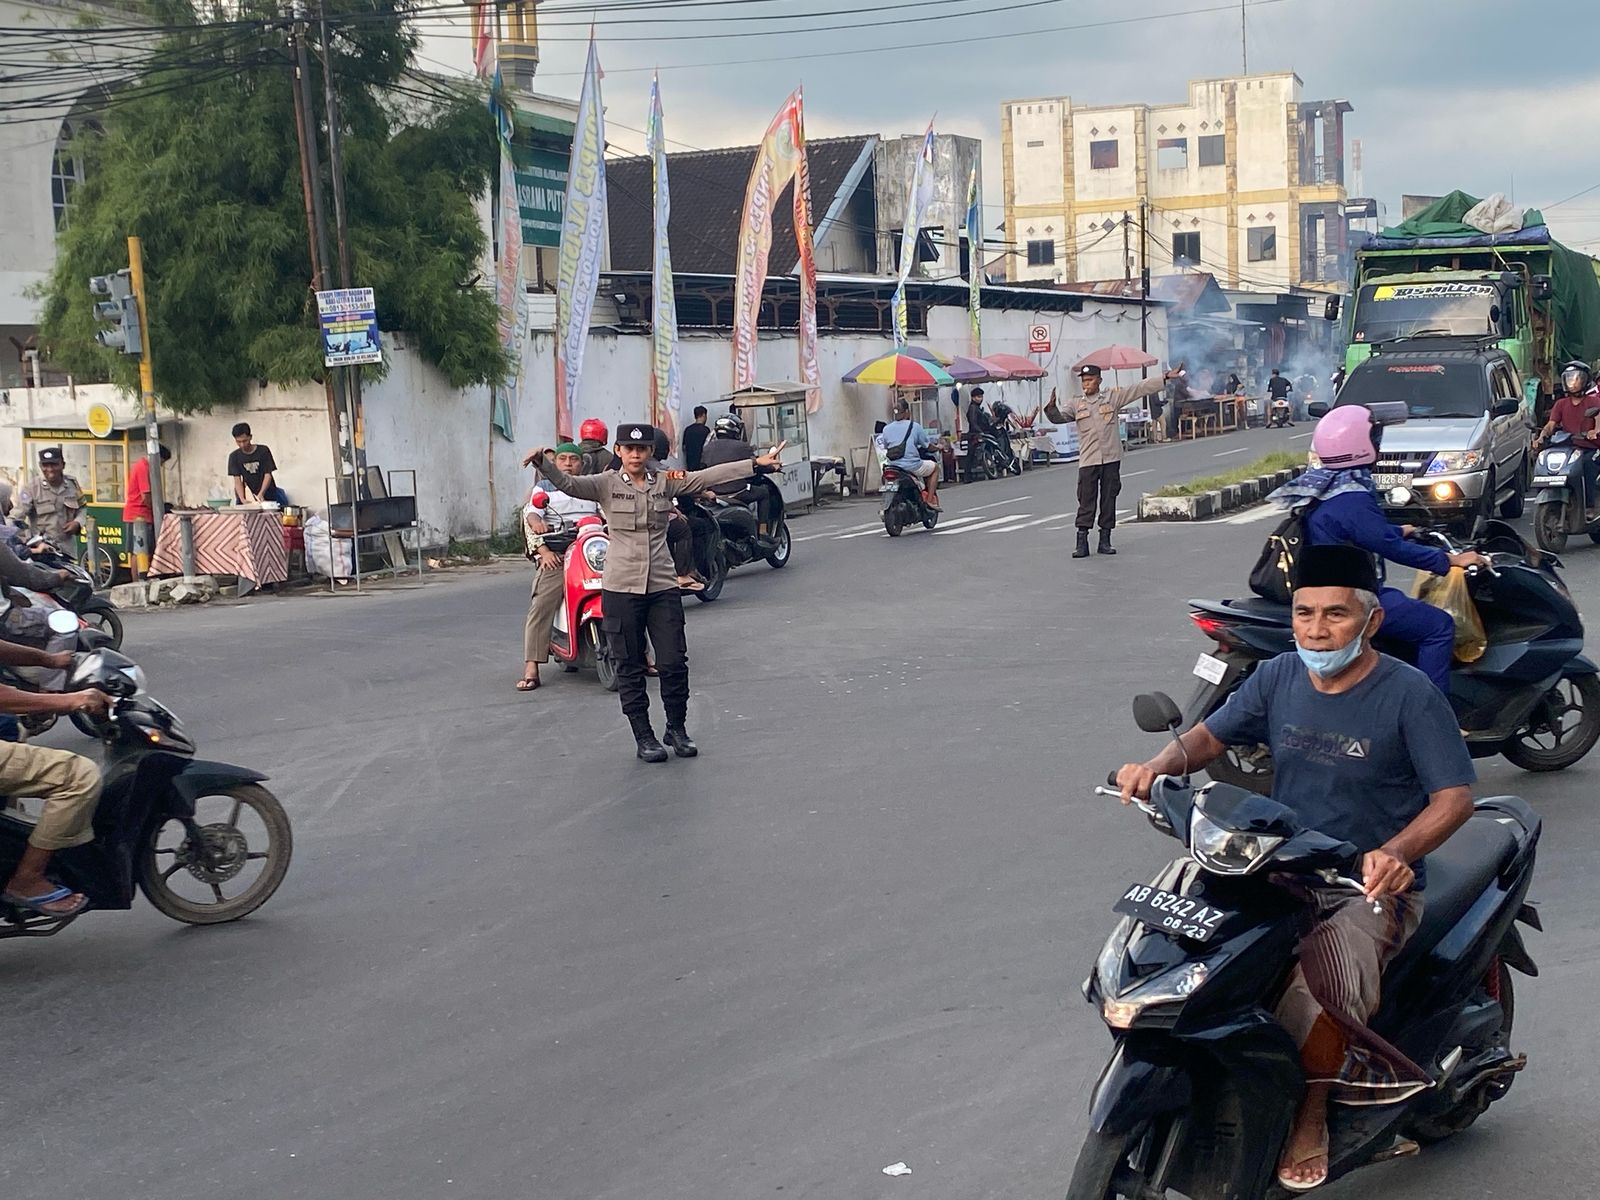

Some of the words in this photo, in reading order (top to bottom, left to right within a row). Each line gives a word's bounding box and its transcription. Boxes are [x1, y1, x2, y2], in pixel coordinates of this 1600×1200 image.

[517, 184, 547, 211] ASRAMA
[1123, 885, 1152, 903] AB
[1150, 890, 1196, 918] 6242
[1190, 905, 1225, 928] AZ
